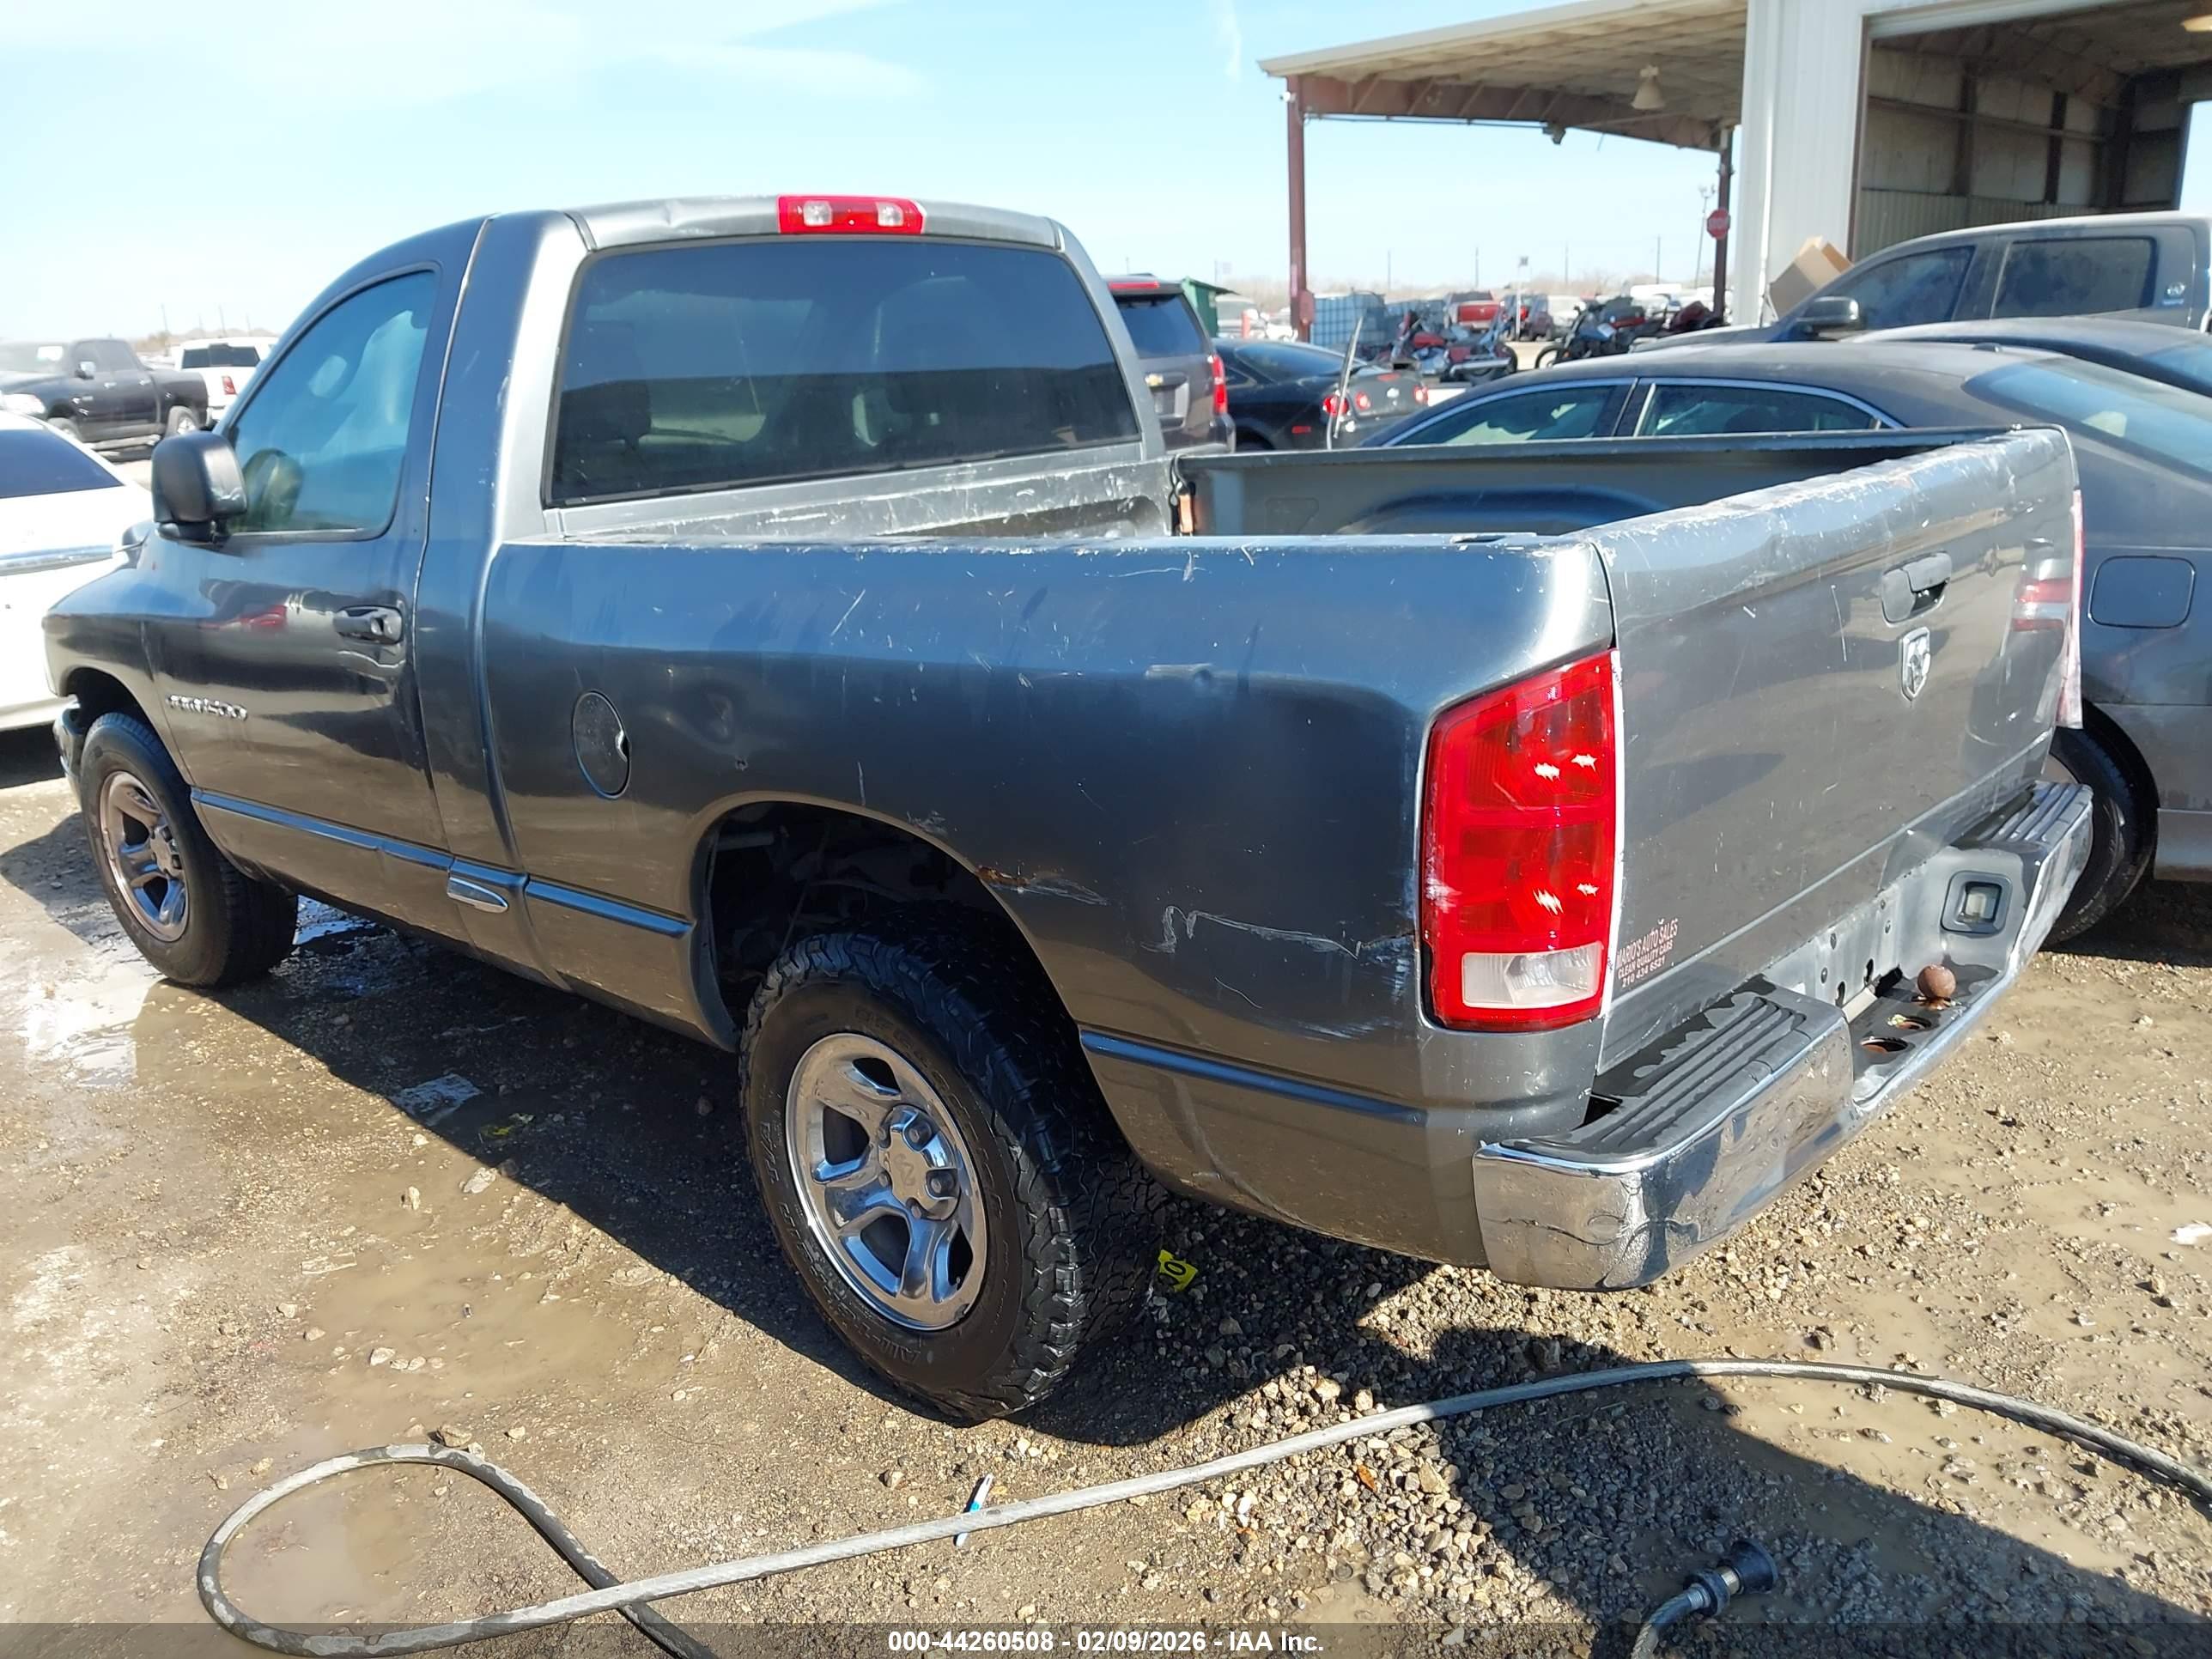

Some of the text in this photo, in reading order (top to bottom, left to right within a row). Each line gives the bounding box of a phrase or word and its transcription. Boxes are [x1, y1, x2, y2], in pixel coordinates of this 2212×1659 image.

[1641, 928, 1659, 955] AUTO
[1659, 918, 1678, 944] SALES
[1618, 939, 1673, 979] CLEAN QUALITY CARS
[1622, 973, 1635, 988] 210
